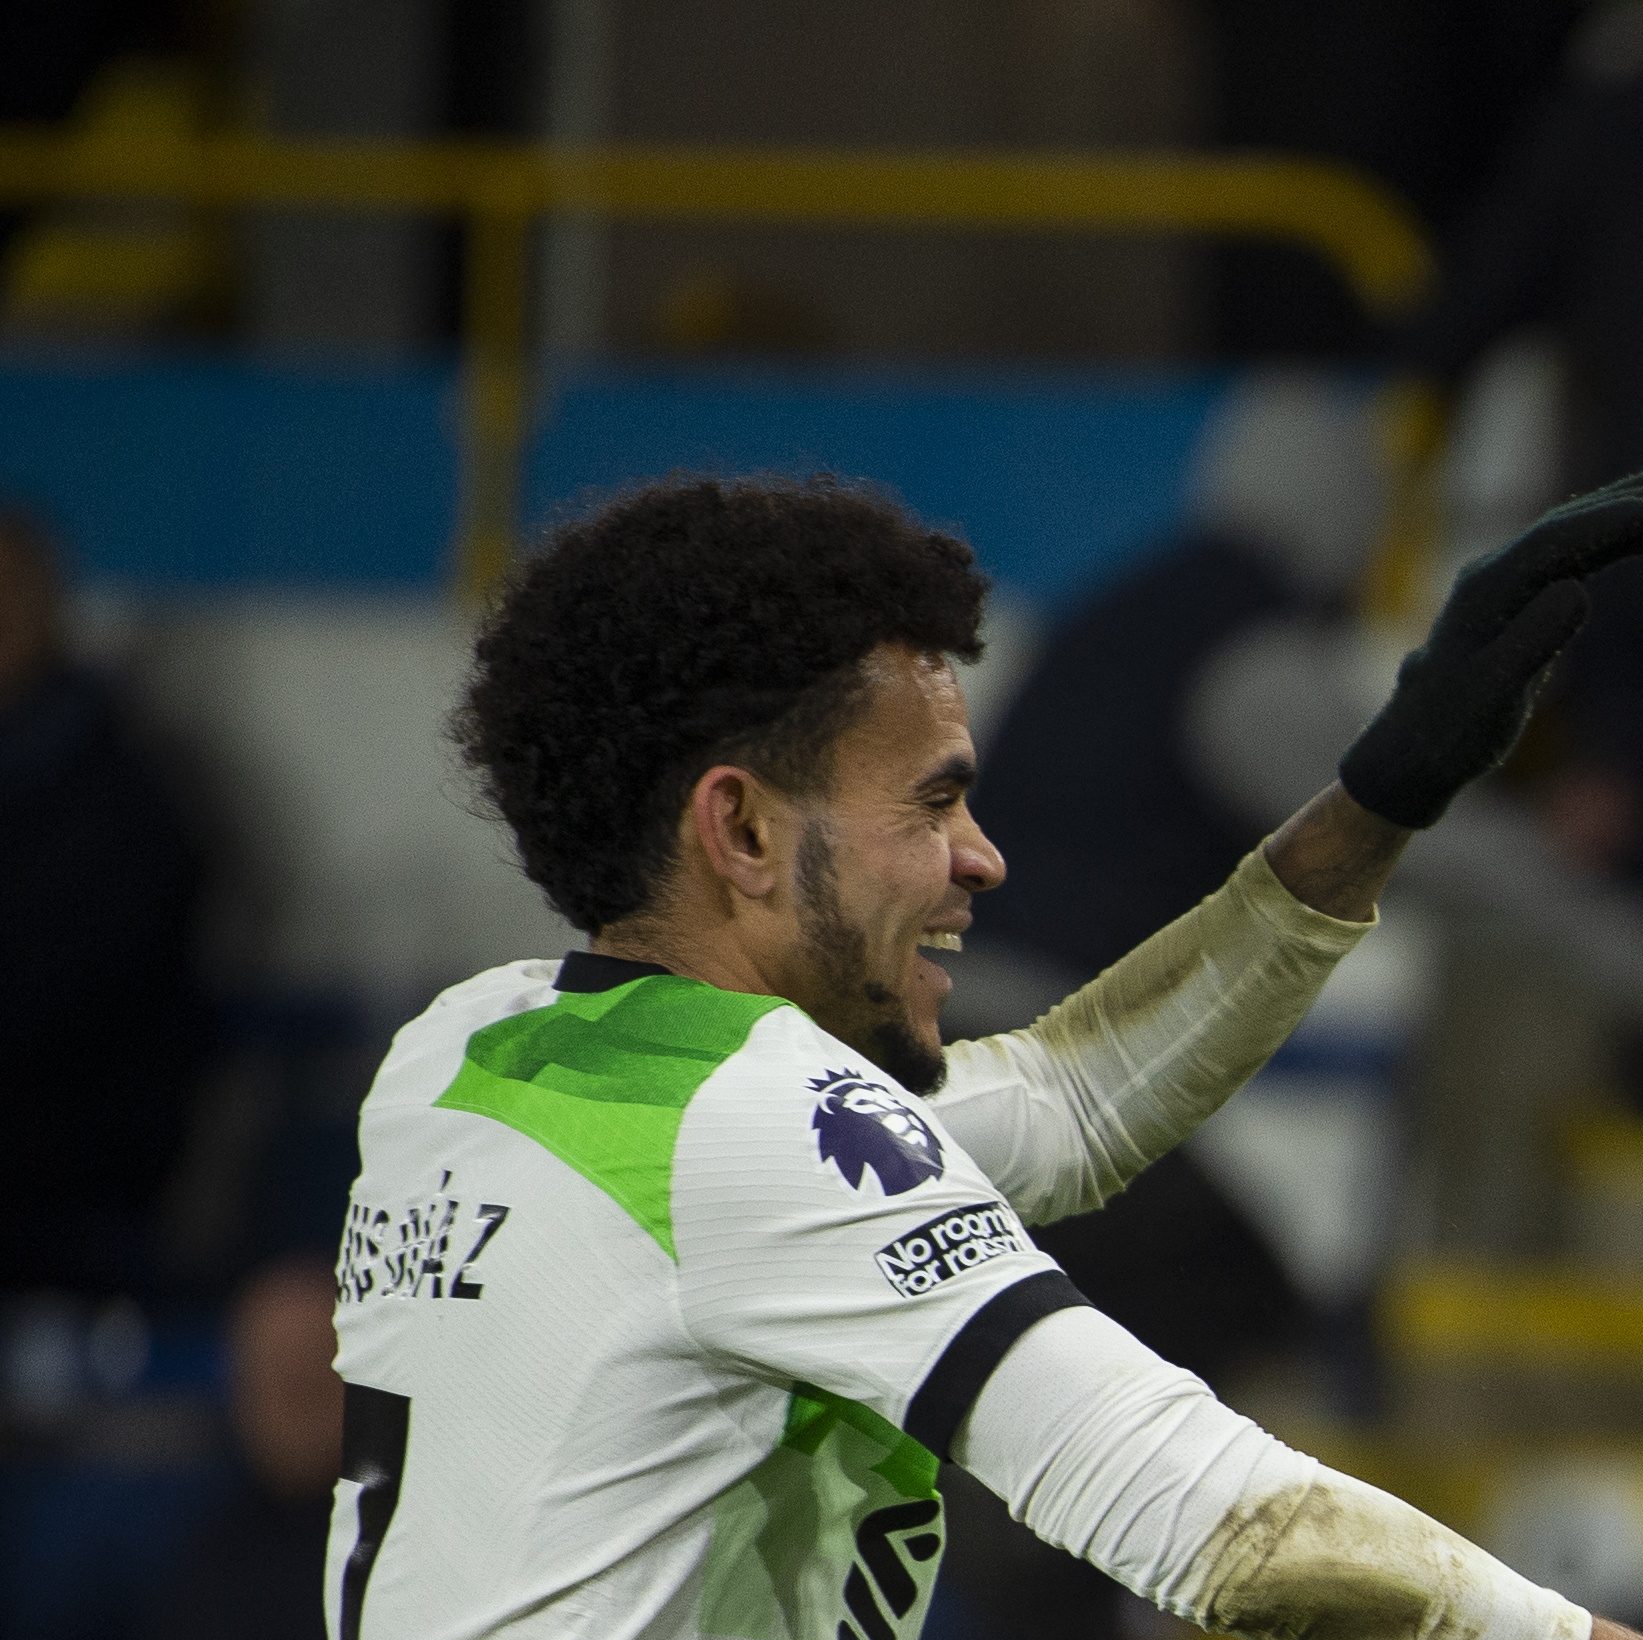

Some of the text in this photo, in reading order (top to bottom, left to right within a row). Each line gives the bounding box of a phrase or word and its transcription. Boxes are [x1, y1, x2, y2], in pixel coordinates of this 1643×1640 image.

[876, 1208, 1012, 1282] No room
[892, 1259, 943, 1299] for
